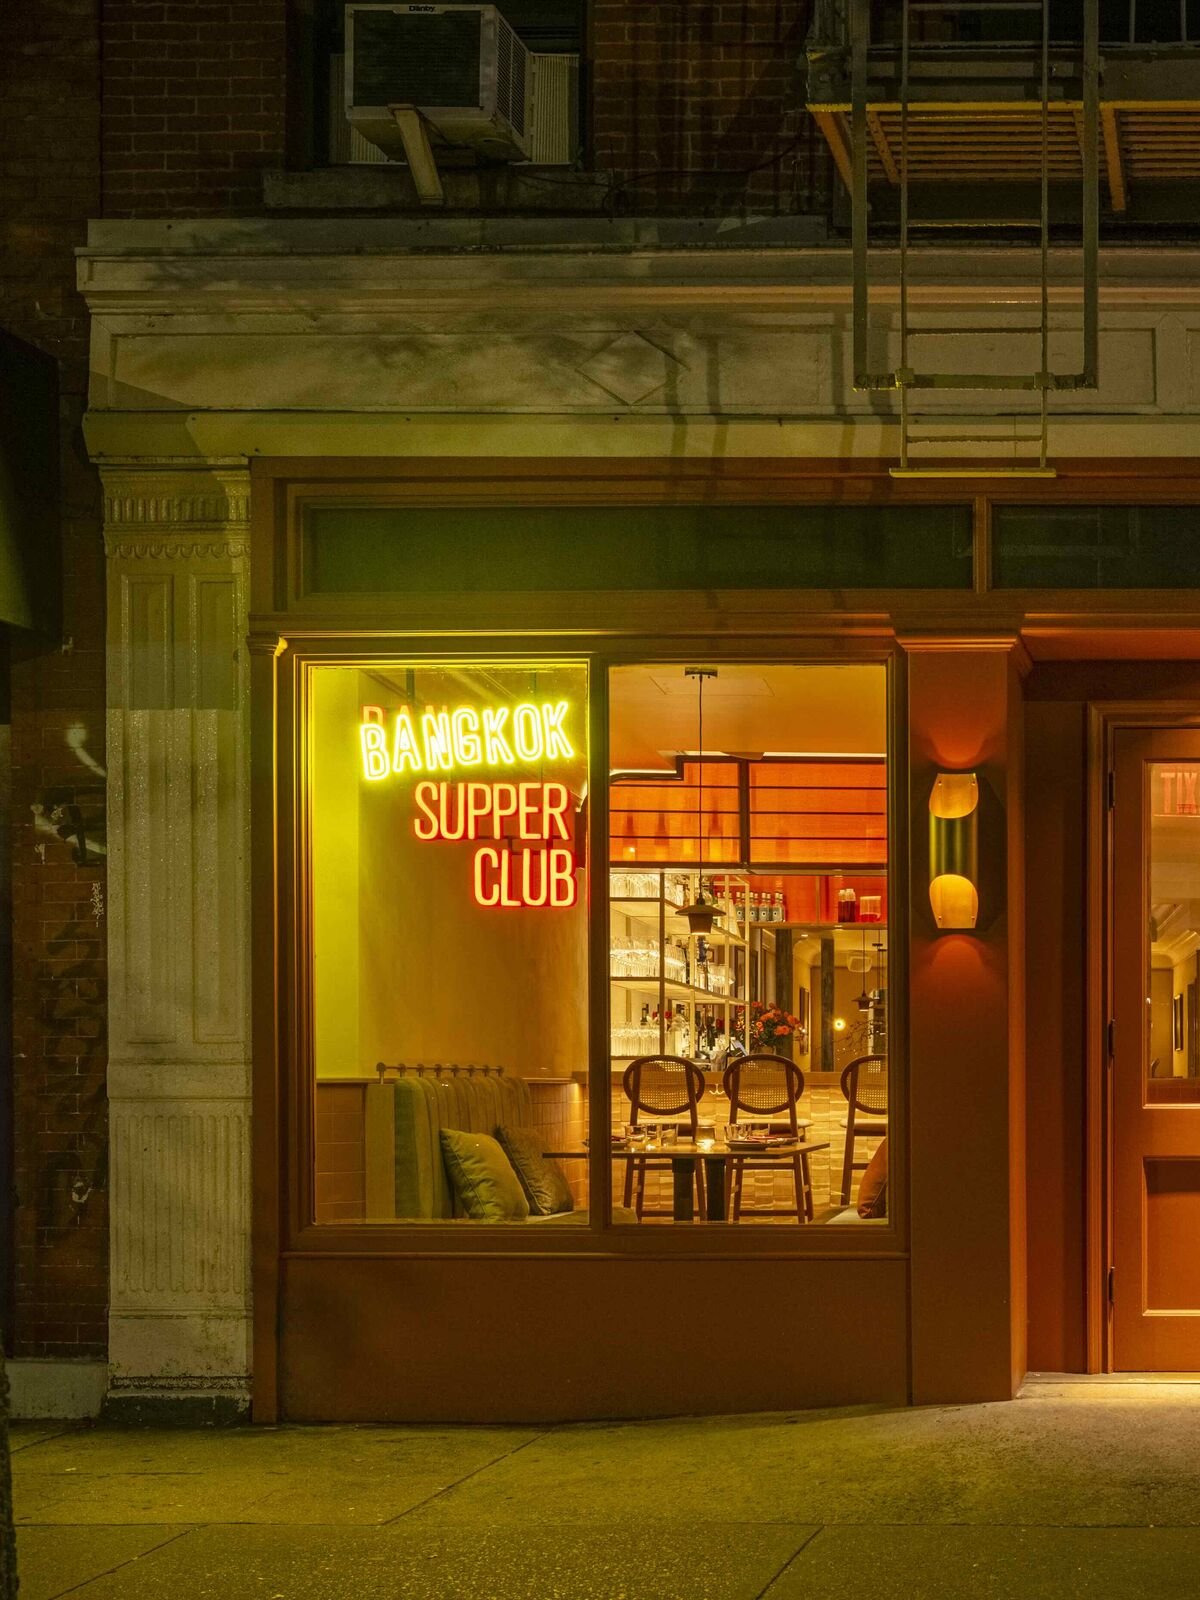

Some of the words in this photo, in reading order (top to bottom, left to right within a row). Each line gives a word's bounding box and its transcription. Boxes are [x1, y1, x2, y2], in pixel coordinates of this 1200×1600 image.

[408, 5, 436, 13] Danby
[359, 701, 575, 781] BANGKOK
[413, 781, 570, 841] SUPPER
[473, 847, 577, 907] CLUB
